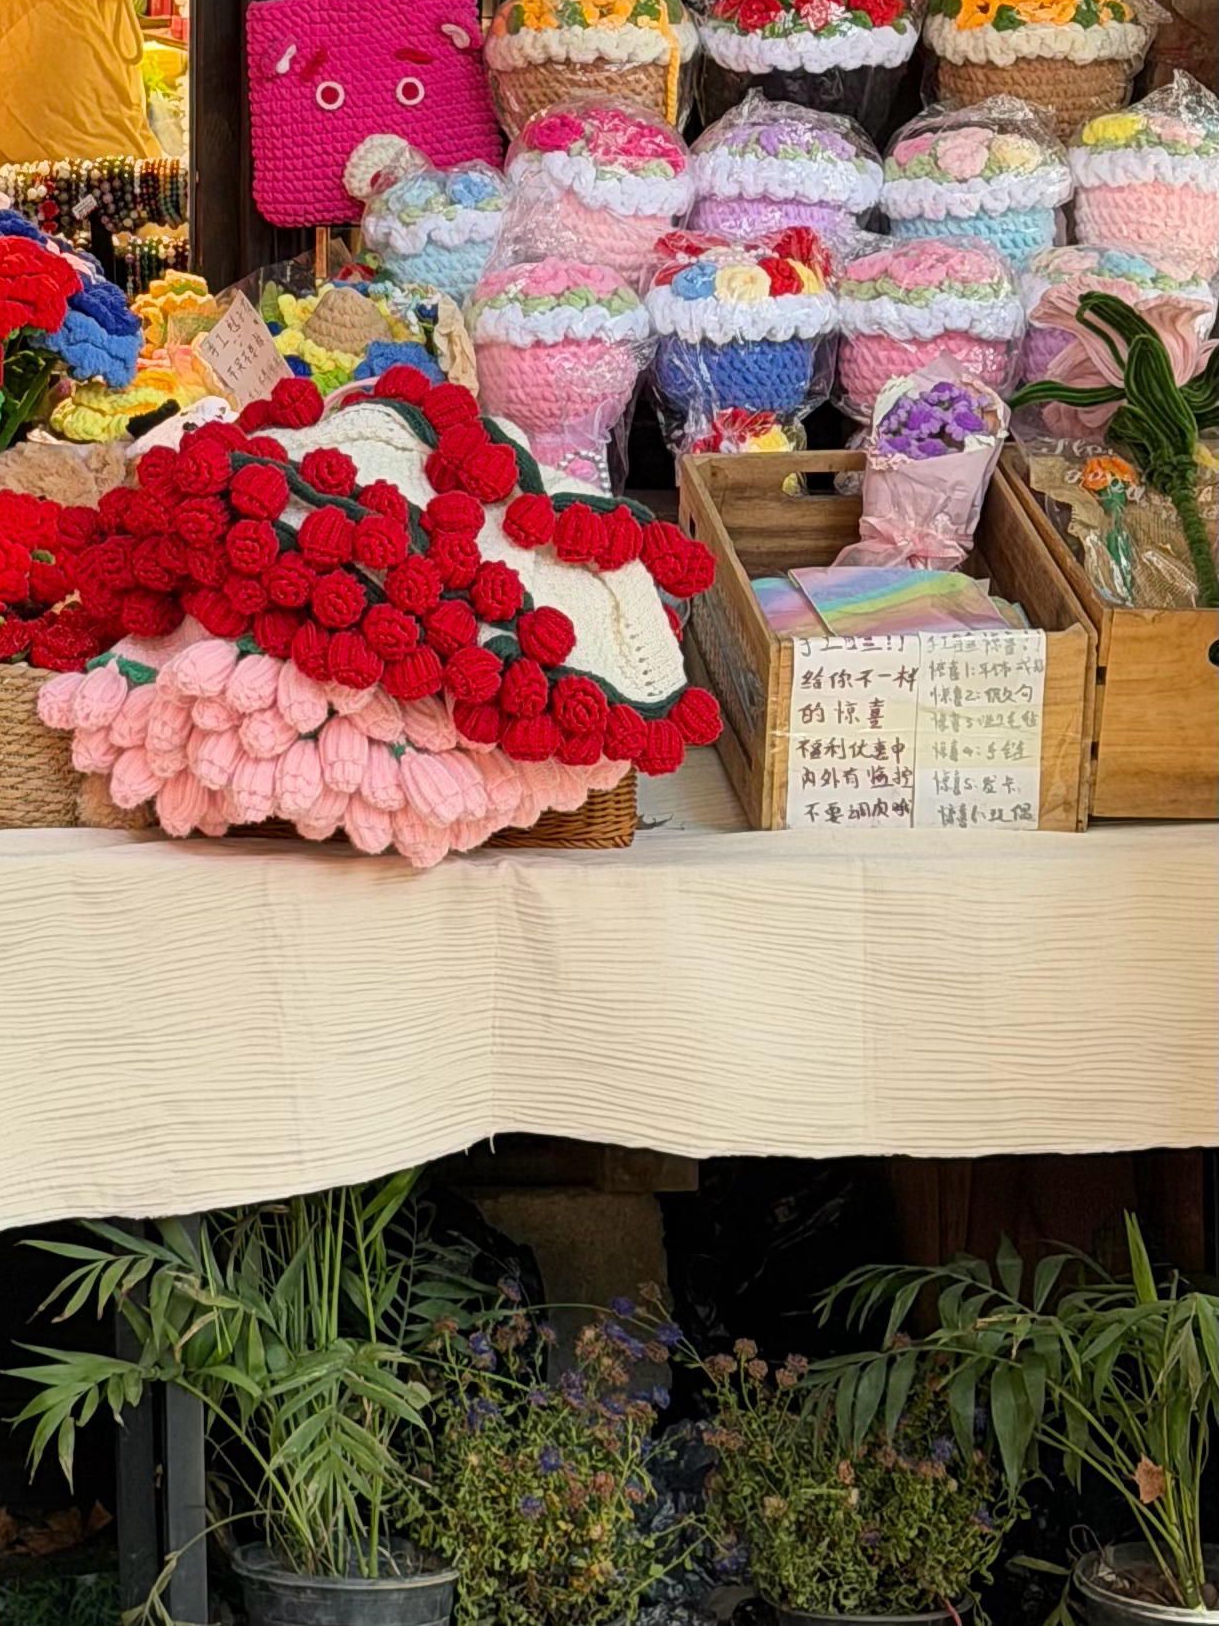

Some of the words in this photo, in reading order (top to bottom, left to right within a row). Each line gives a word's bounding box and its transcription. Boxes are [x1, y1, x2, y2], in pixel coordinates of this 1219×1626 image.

[800, 665, 919, 692] 给你不一样
[798, 697, 885, 729] 的惊喜
[796, 736, 906, 764] 福利优惠中
[802, 765, 913, 791] 内外有监控
[804, 798, 912, 824] 不要调皮哦
